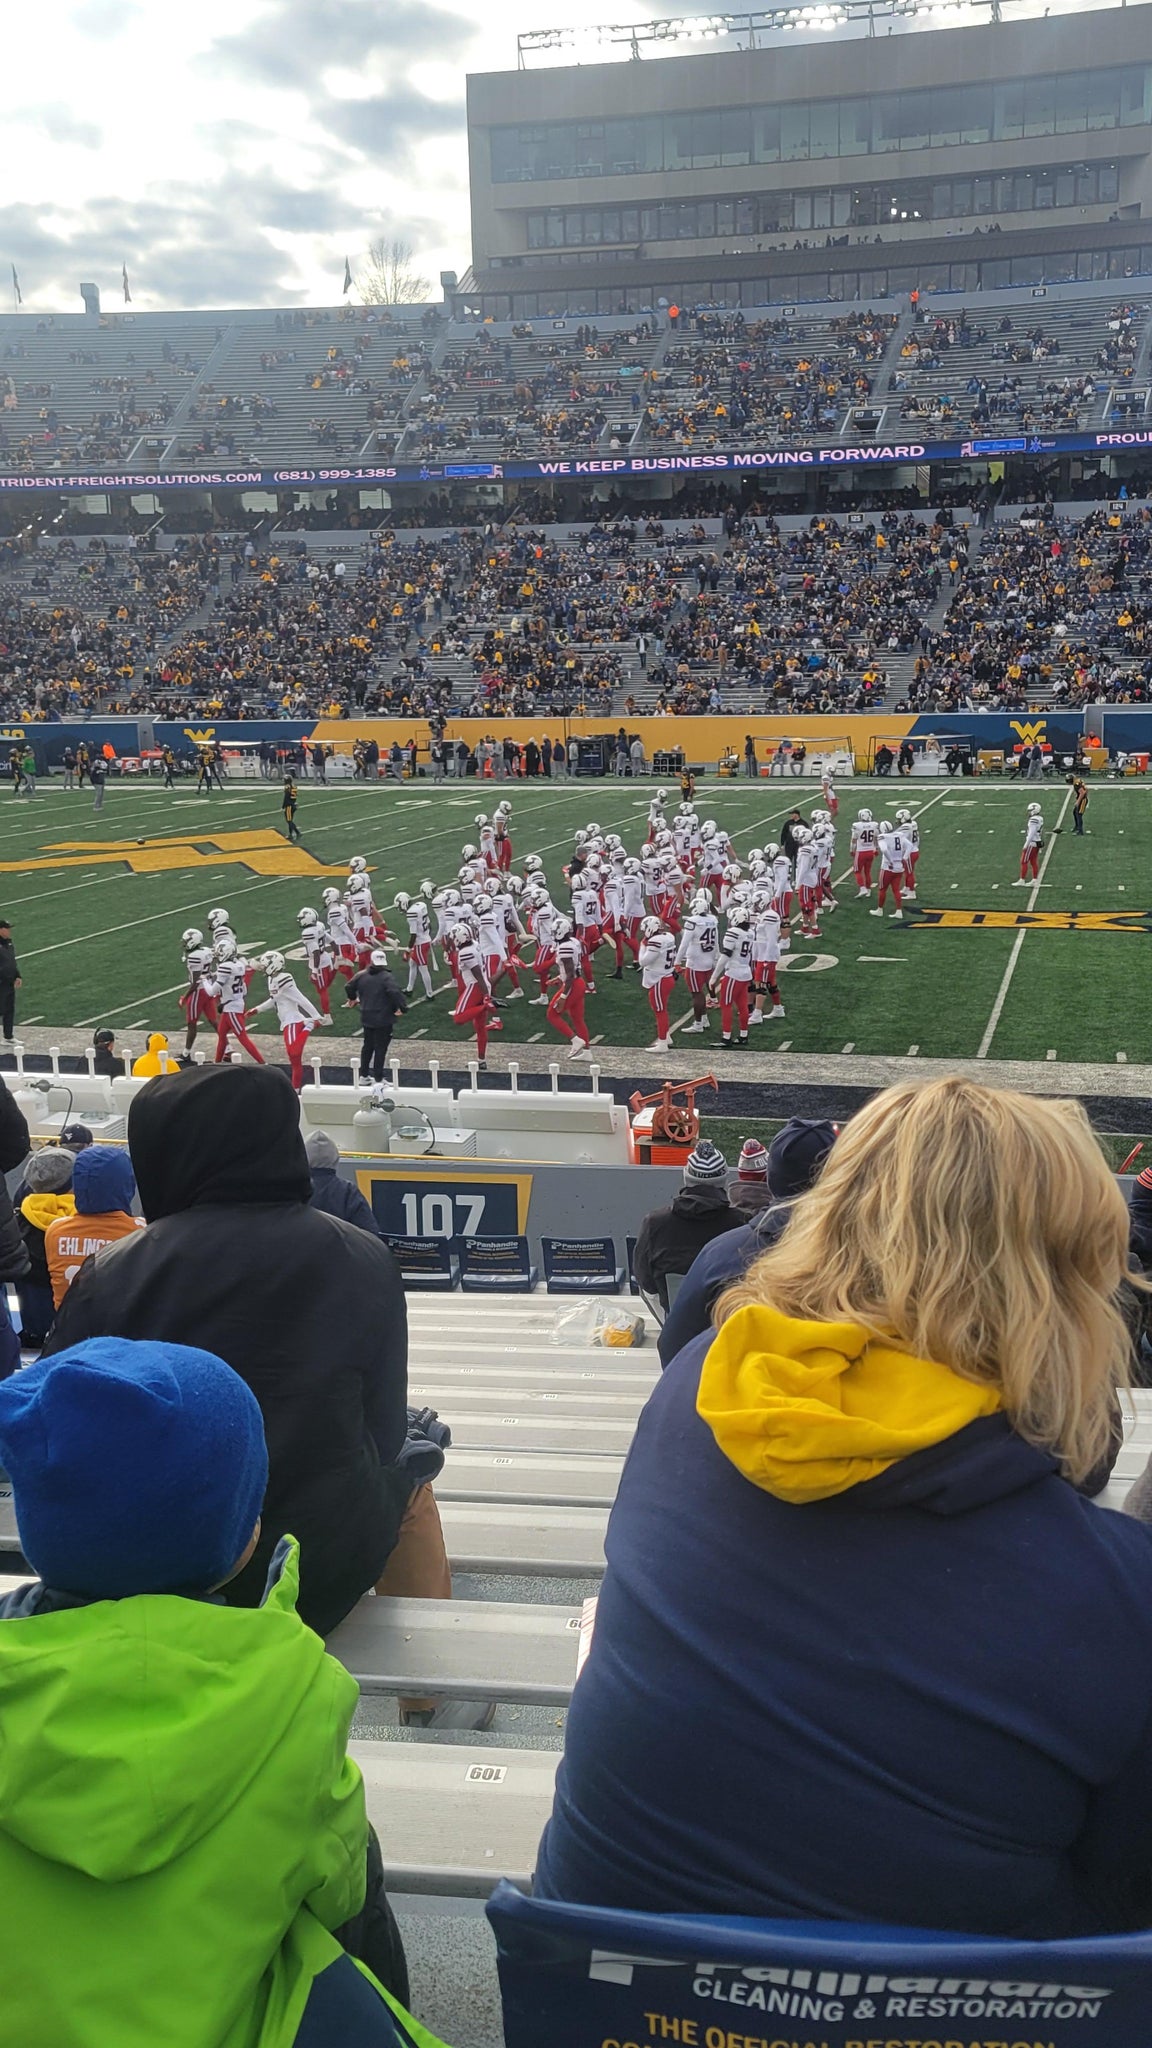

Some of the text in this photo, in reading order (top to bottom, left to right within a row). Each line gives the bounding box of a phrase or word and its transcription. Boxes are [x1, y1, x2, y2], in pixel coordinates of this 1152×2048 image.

[539, 445, 925, 474] WE KEEP BUSINESS MOVING FORWARD
[273, 470, 316, 482] (681)
[319, 467, 396, 480] 999-1385
[860, 829, 875, 843] 46
[585, 901, 597, 915] 37
[401, 1193, 486, 1240] 107
[58, 1236, 112, 1256] EHLIN
[469, 1766, 503, 1781] 109
[692, 1977, 1102, 2022] CLEANING & RESTORATION
[643, 2012, 699, 2046] THE
